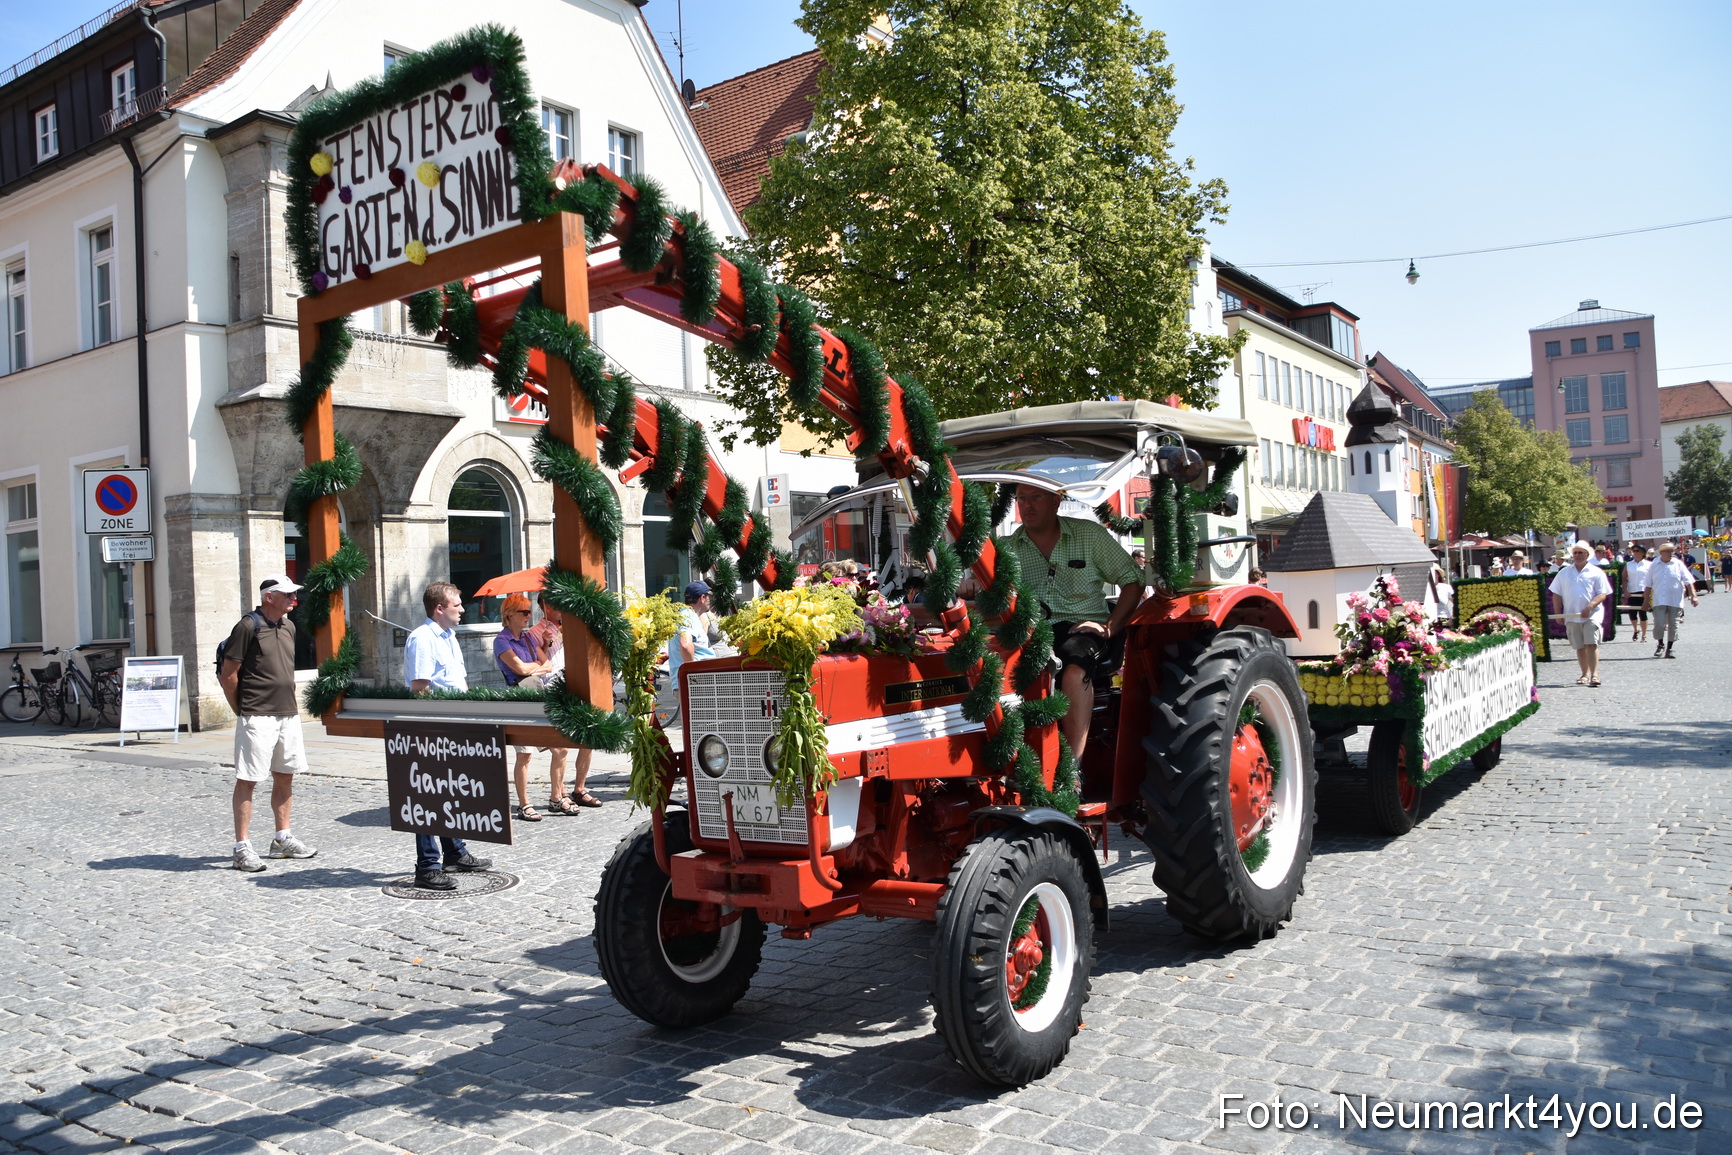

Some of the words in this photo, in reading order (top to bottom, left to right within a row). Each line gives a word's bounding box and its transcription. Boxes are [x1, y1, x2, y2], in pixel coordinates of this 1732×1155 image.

[324, 89, 457, 190] FENSTER
[322, 178, 421, 284] GARTEN
[440, 148, 523, 243] SINNE
[101, 518, 134, 529] ZONE
[901, 685, 956, 700] INTERNATIONAL
[1425, 675, 1439, 716] AS
[409, 761, 485, 797] Garten
[736, 785, 760, 802] NM
[401, 796, 437, 826] der
[443, 800, 503, 833] Sinne
[754, 806, 773, 823] 67
